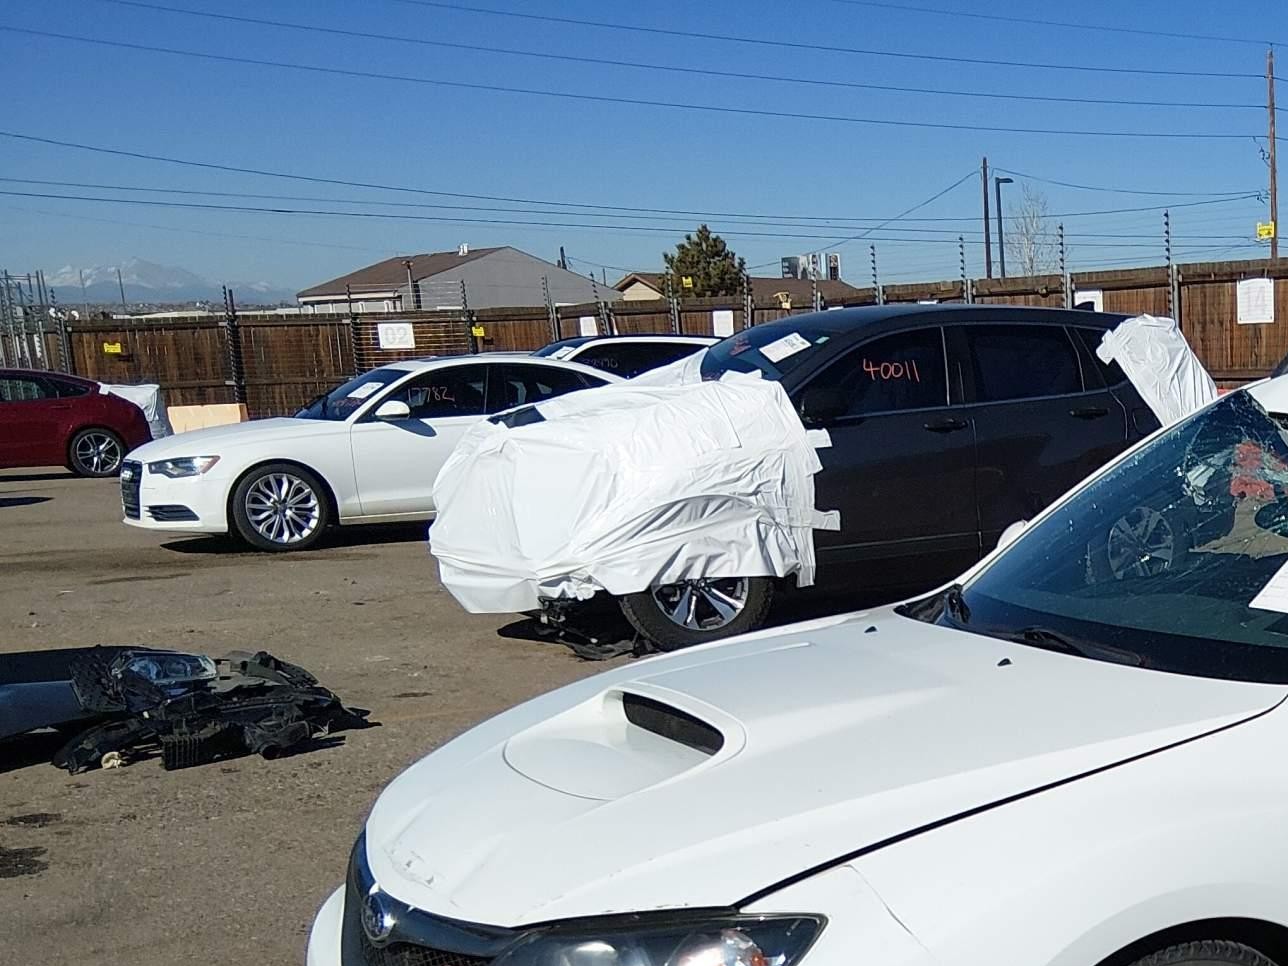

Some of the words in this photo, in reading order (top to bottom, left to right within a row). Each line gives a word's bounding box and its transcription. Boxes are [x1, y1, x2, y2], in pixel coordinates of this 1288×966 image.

[384, 326, 410, 345] 02
[863, 358, 920, 382] 40011
[407, 386, 455, 403] 17782
